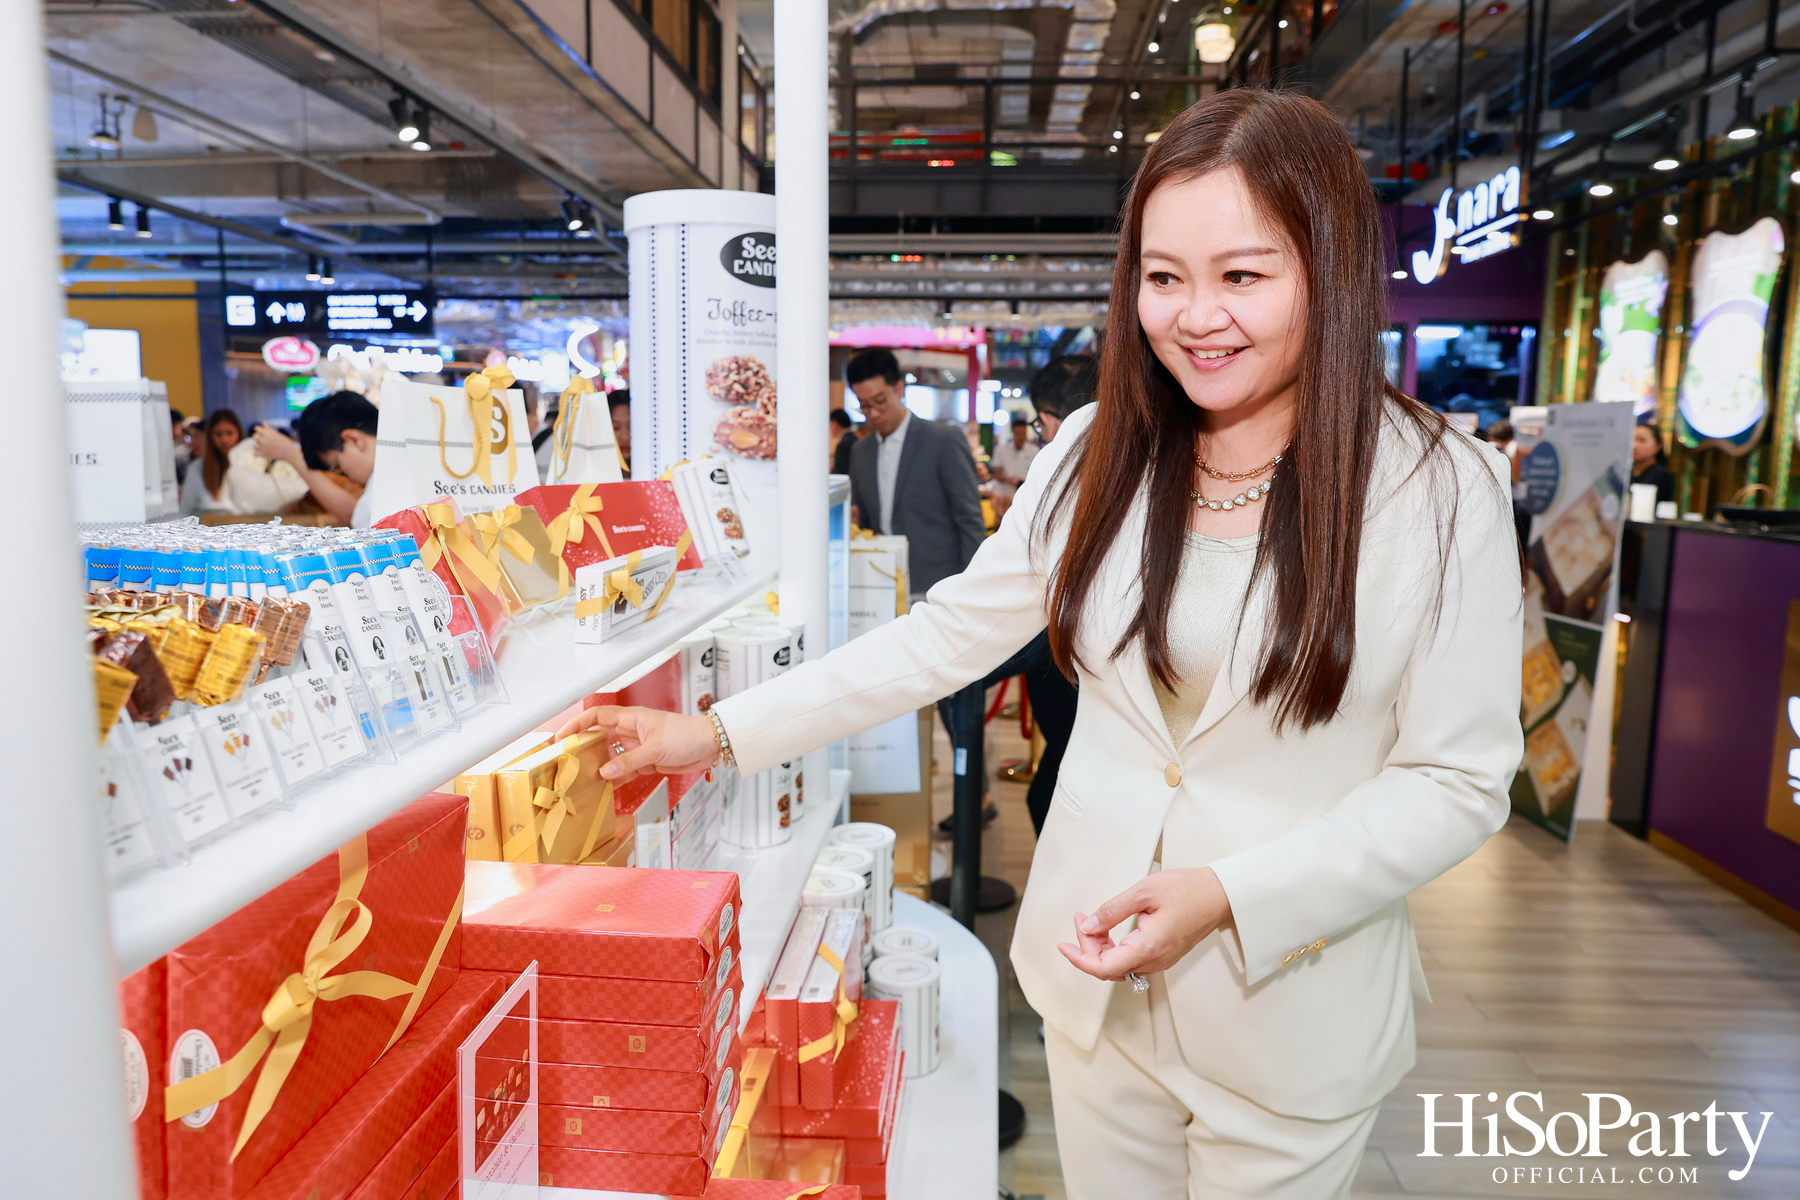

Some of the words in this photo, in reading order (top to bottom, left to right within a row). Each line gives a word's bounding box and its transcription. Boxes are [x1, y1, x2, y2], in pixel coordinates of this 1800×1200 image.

[1457, 166, 1521, 234] nara
[741, 236, 776, 261] See
[733, 259, 776, 276] CANDI
[707, 297, 777, 326] Toffee-
[434, 480, 467, 495] See's
